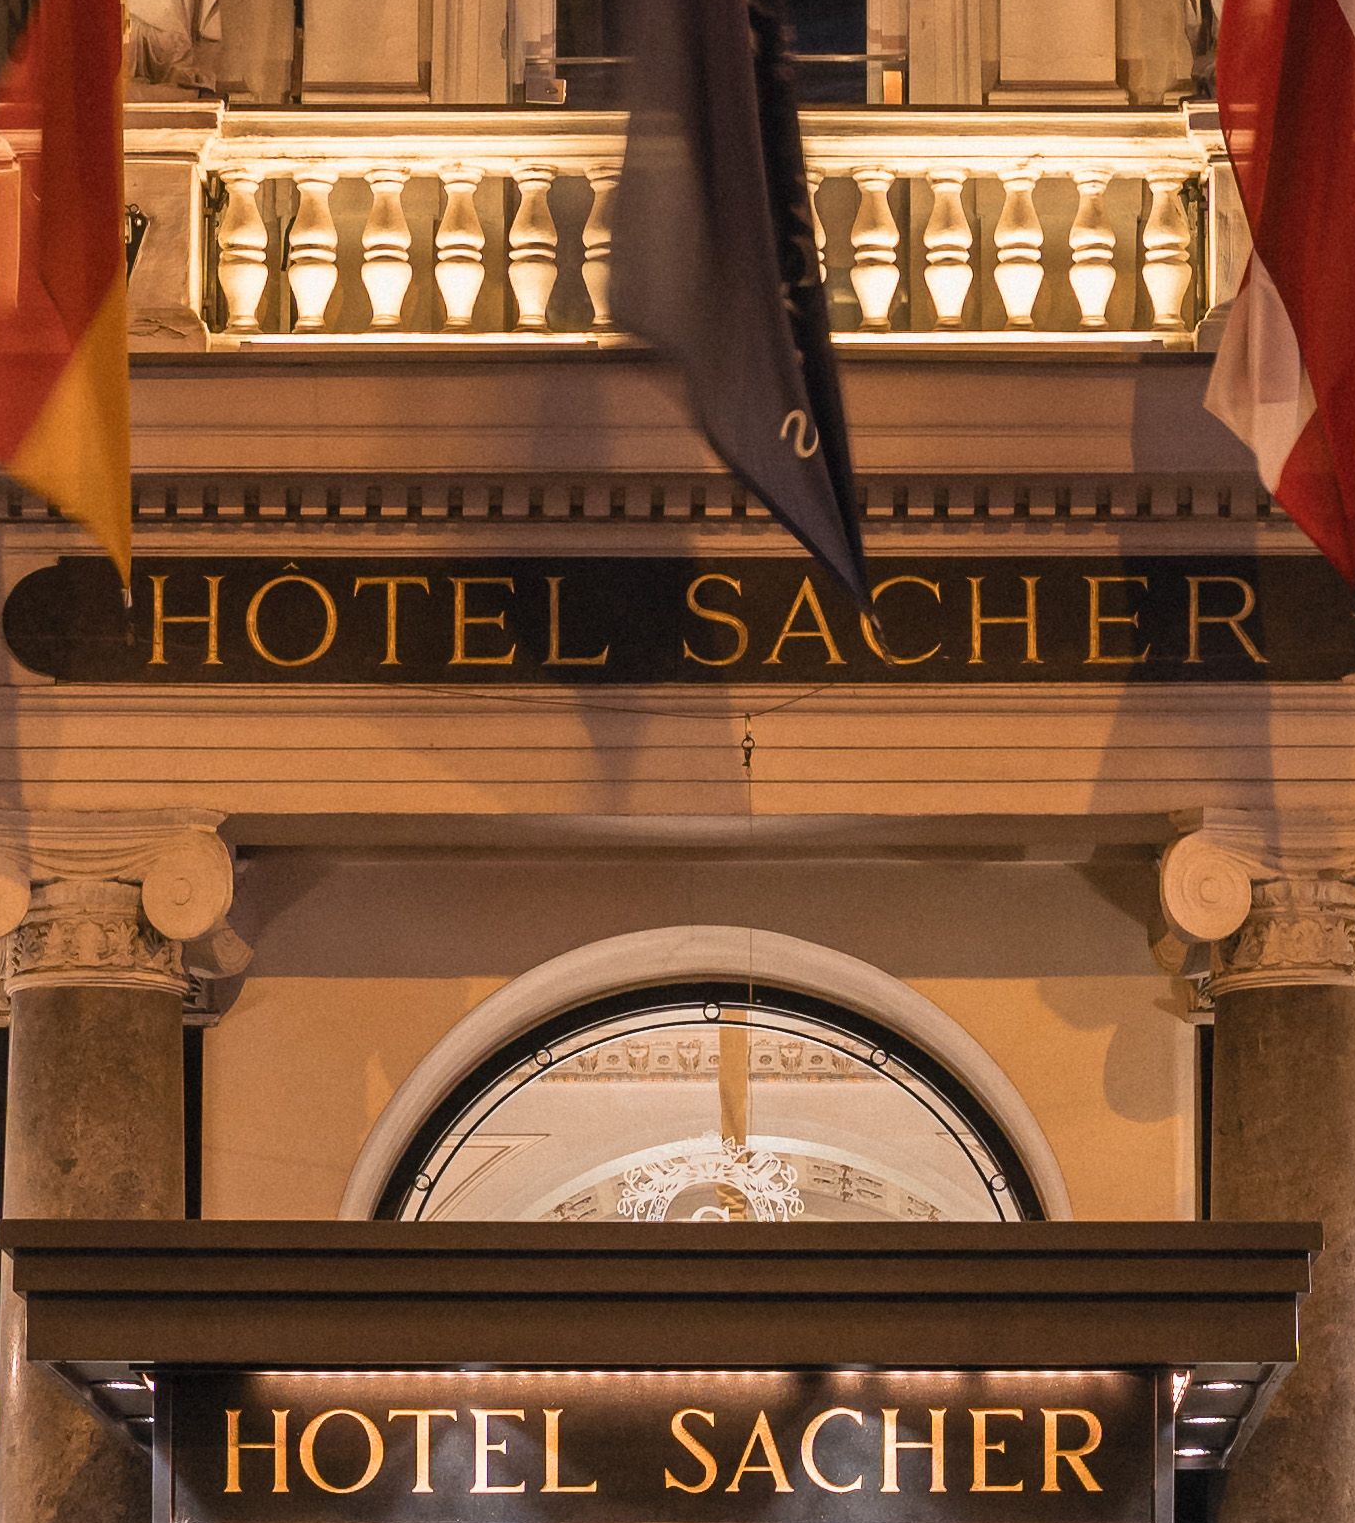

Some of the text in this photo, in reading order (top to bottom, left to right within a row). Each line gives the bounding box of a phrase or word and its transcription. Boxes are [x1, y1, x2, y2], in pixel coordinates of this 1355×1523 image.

[147, 562, 1271, 667] HÔTEL SACHER
[223, 1407, 1104, 1494] HOTEL SACHER
